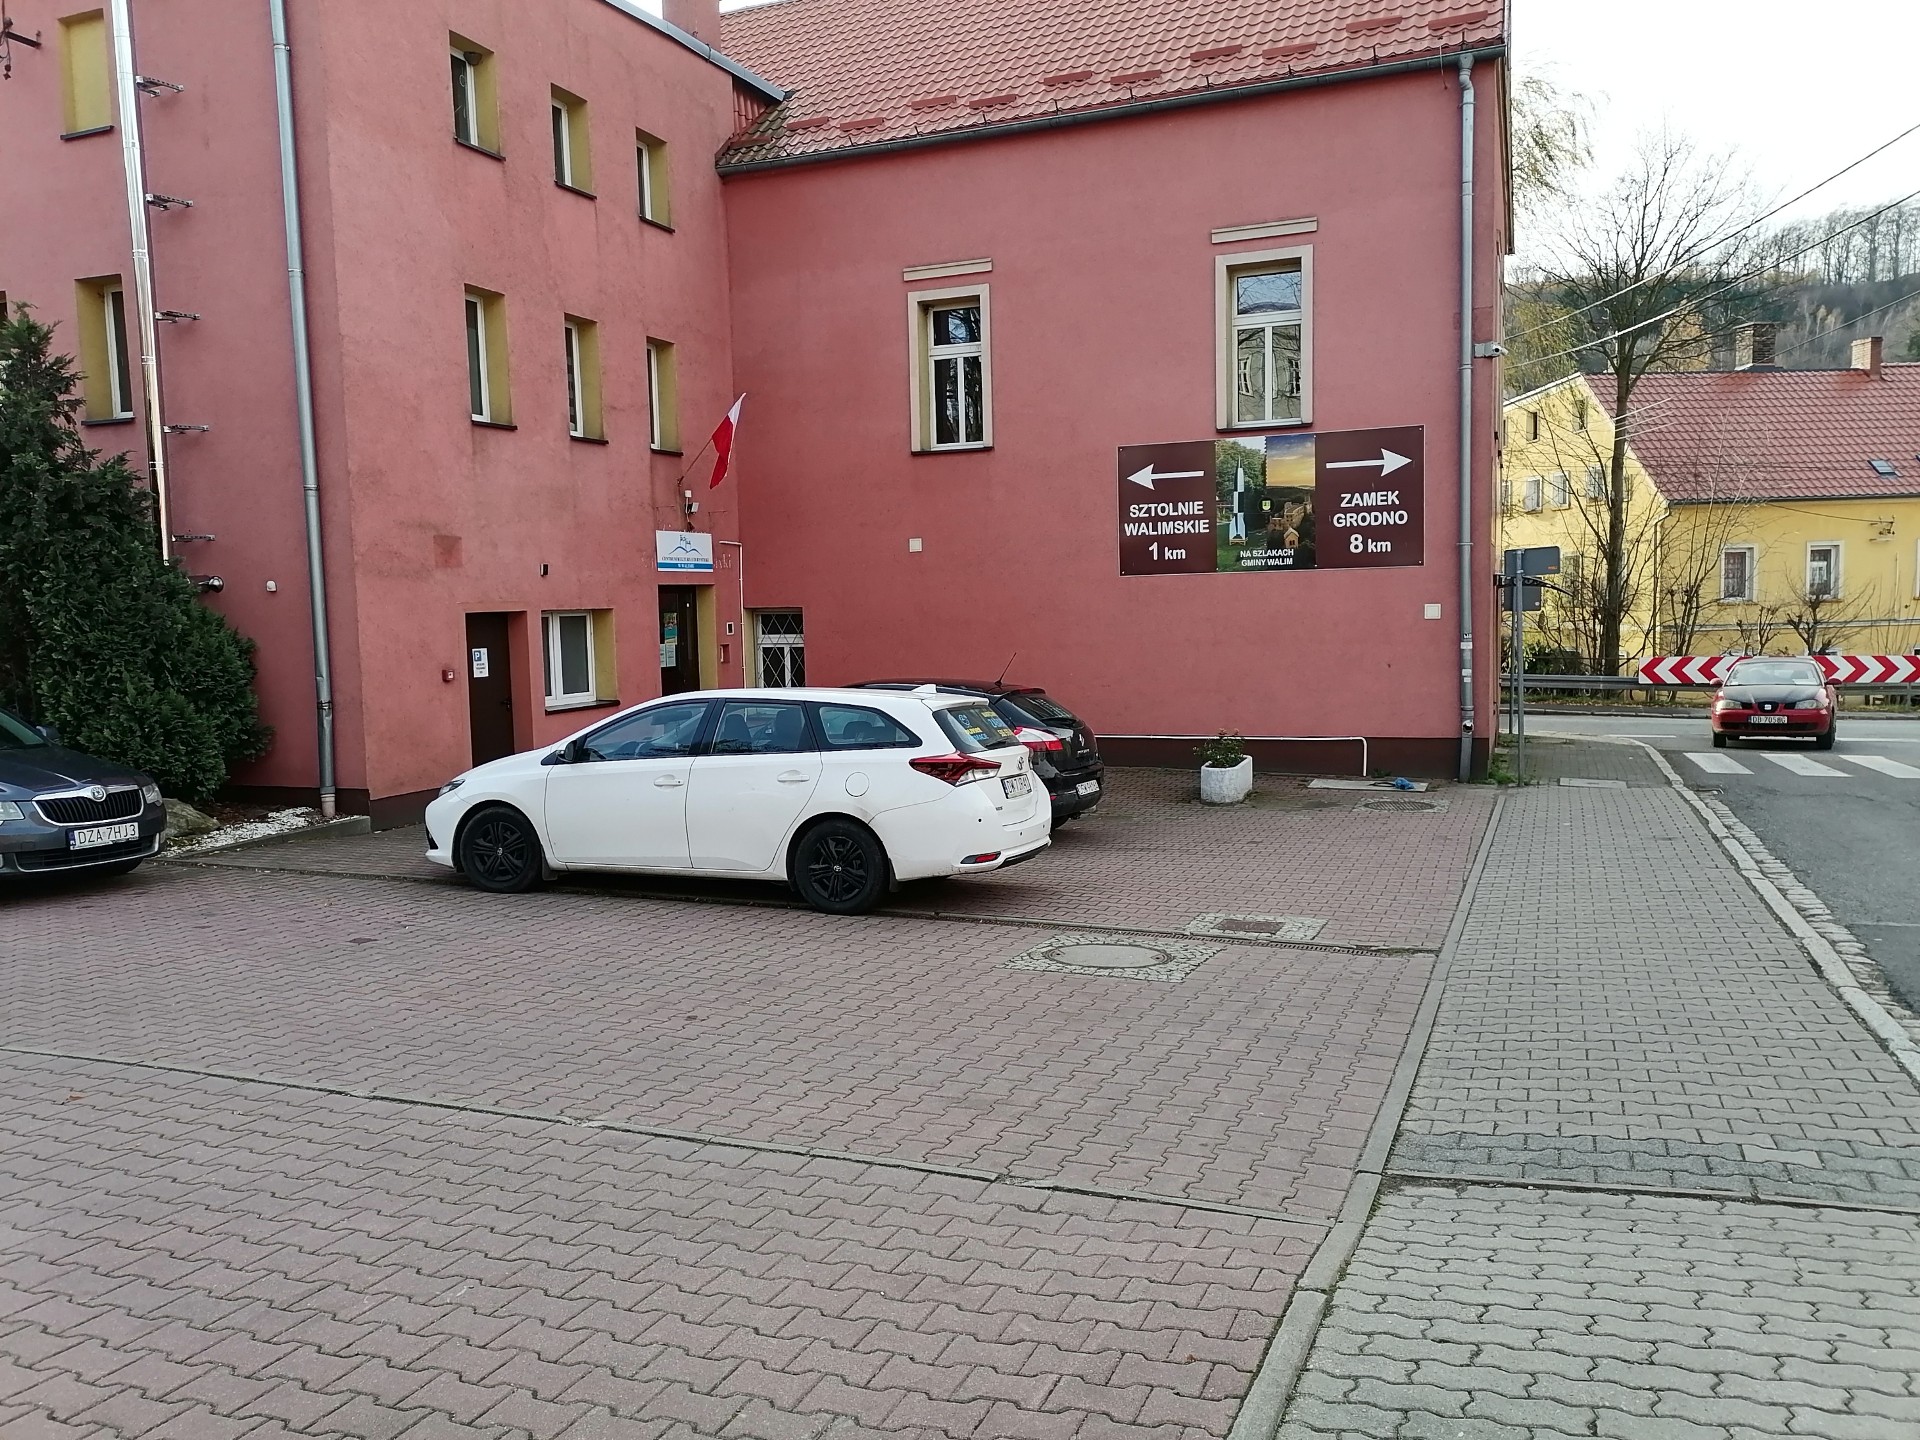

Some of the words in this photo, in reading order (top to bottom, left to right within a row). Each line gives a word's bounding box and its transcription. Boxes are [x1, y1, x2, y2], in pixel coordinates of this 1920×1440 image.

[1340, 490, 1400, 508] ZAMEK
[1129, 500, 1204, 518] SZTOLNIE
[1124, 519, 1210, 537] WALIMSKIE
[1332, 510, 1408, 528] GRODNO
[1148, 541, 1158, 561] 1
[1164, 546, 1186, 561] km
[1349, 533, 1364, 554] 8
[1367, 538, 1392, 553] km
[1240, 550, 1251, 558] NA
[1252, 549, 1294, 557] SZLAKACH
[1241, 559, 1266, 567] GMINY
[1267, 558, 1293, 566] WALIM
[78, 829, 103, 844] DZA
[106, 824, 136, 839] 7HJ3
